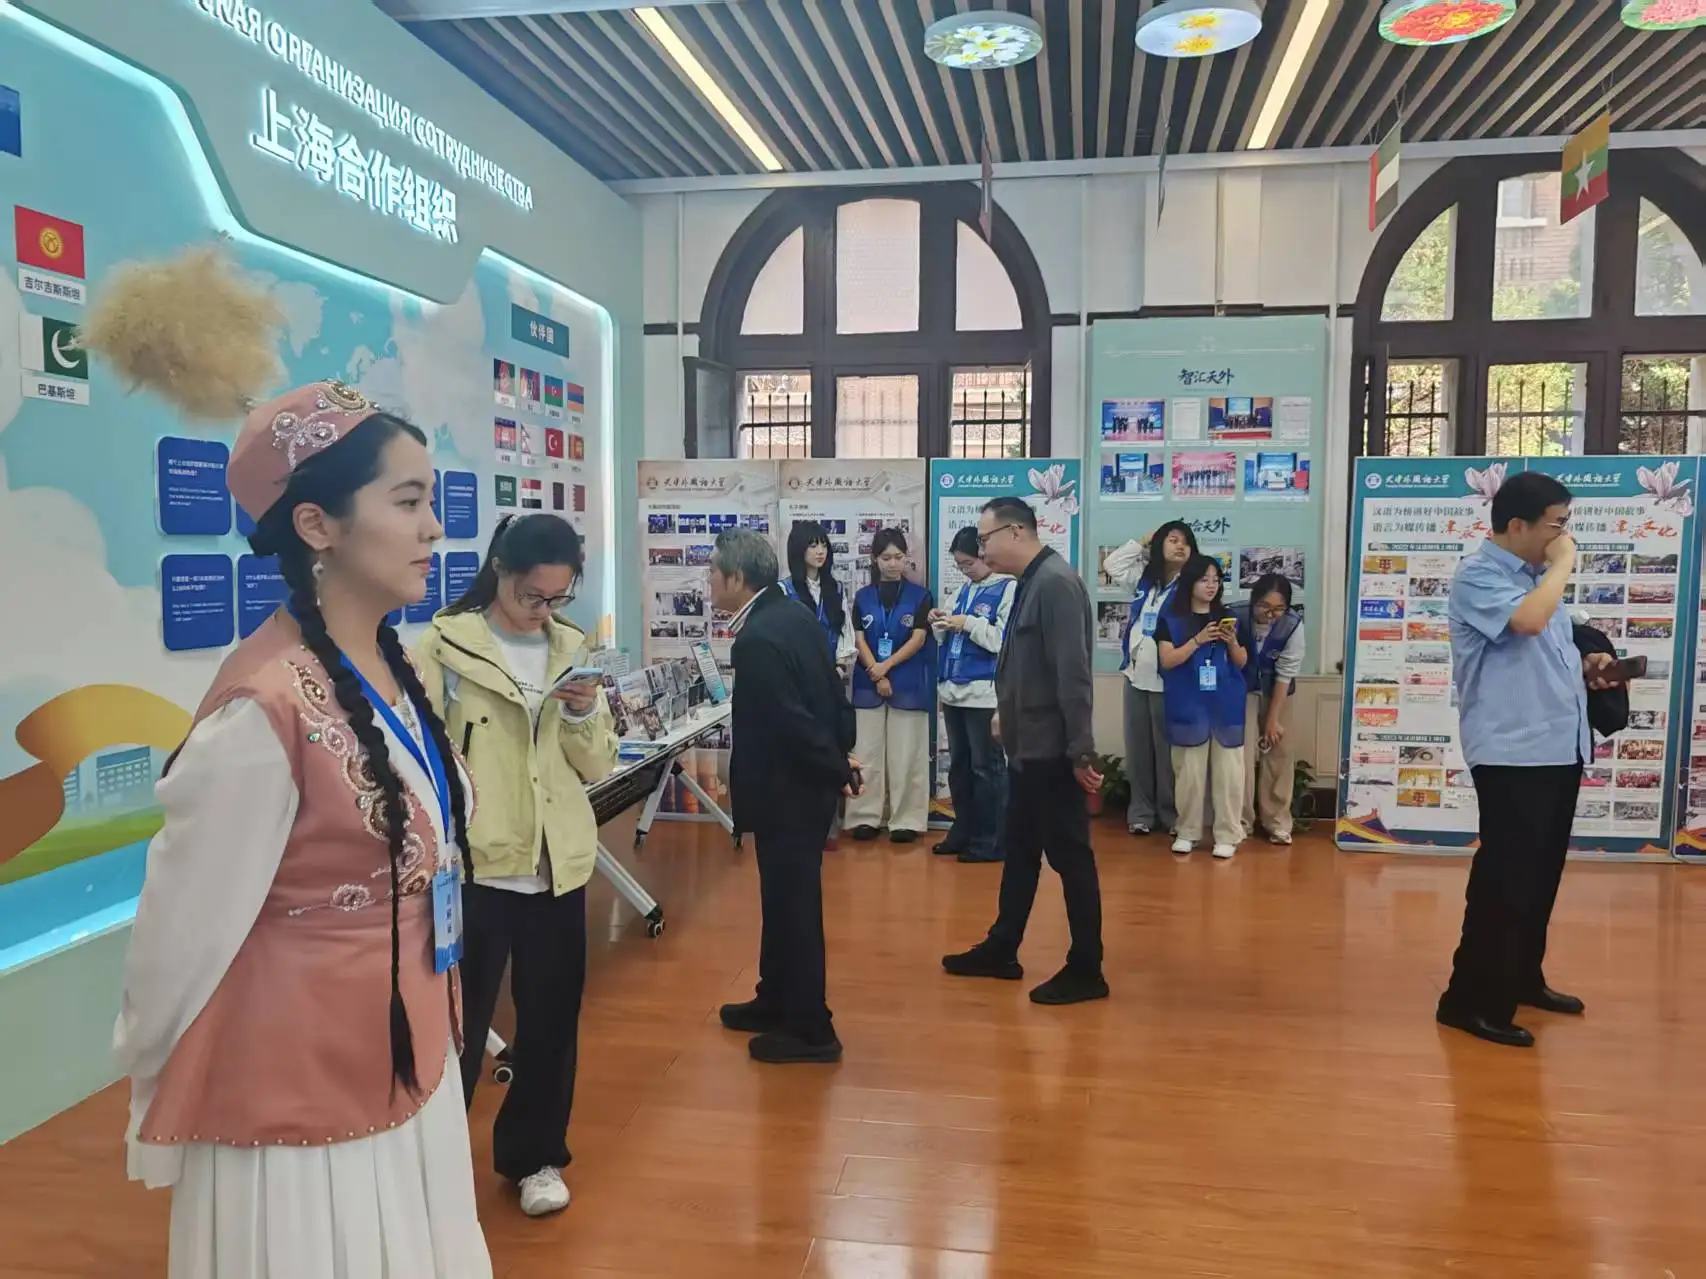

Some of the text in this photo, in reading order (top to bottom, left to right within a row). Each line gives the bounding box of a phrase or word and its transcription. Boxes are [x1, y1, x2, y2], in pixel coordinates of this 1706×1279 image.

[264, 20, 411, 135] ОРГАНИЗАЦИЯ
[411, 111, 533, 212] СОТРУДНИЧЕСТВА
[250, 85, 458, 243] 上海合作组织
[24, 276, 81, 300] 吉尔吉斯斯坦
[1178, 367, 1235, 386] 智汇天外
[38, 383, 77, 400] 巴基斯坦
[1372, 504, 1475, 517] 汉语为桥讲好中国故事
[1372, 521, 1437, 533] 语言为媒传播
